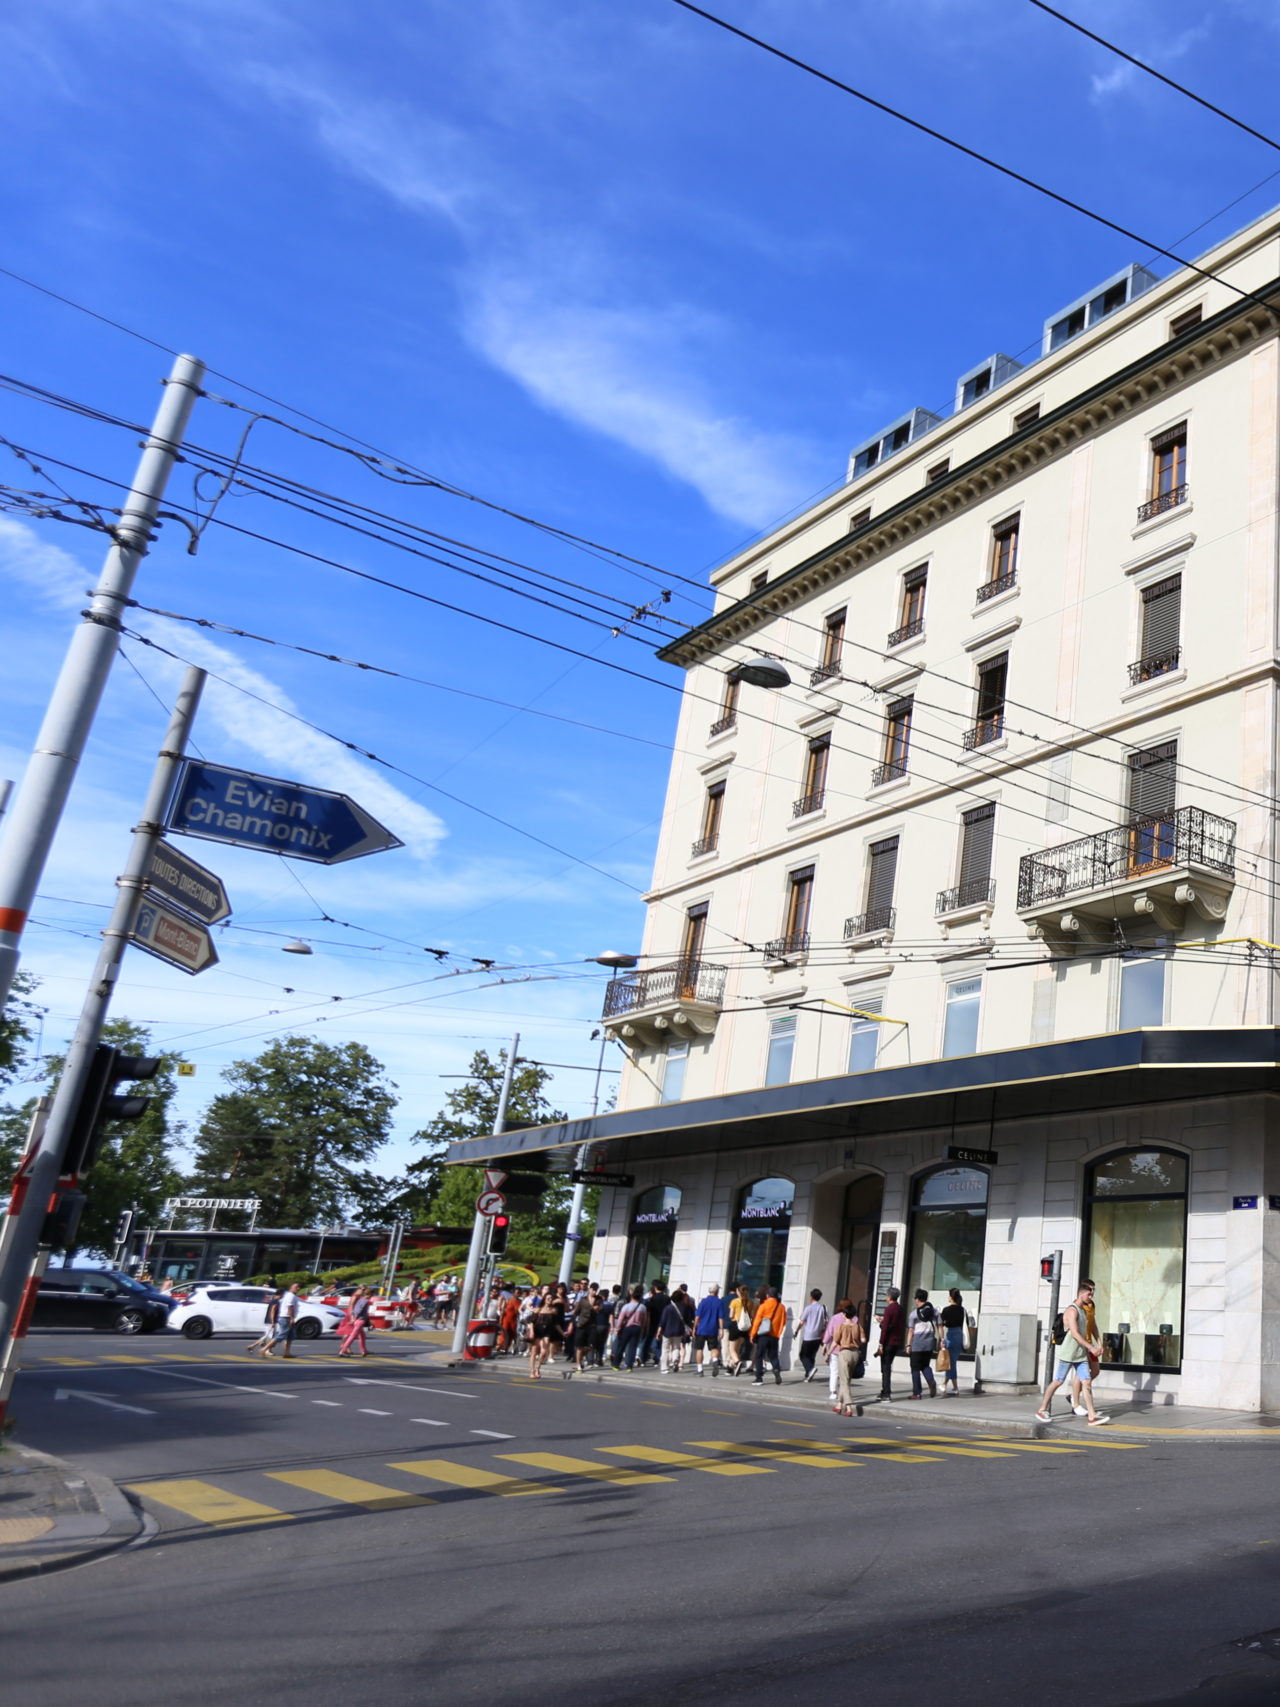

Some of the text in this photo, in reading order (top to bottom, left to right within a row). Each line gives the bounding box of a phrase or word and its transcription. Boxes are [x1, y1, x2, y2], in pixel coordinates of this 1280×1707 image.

[224, 780, 308, 819] Evian
[184, 797, 334, 850] Chamonix
[152, 855, 218, 911] TOUTES DIRECTIONS
[141, 914, 199, 955] P Mont-Blanc
[166, 1198, 181, 1208] LA
[636, 1211, 669, 1223] MONTBLANC
[741, 1207, 780, 1219] MONTBLANC
